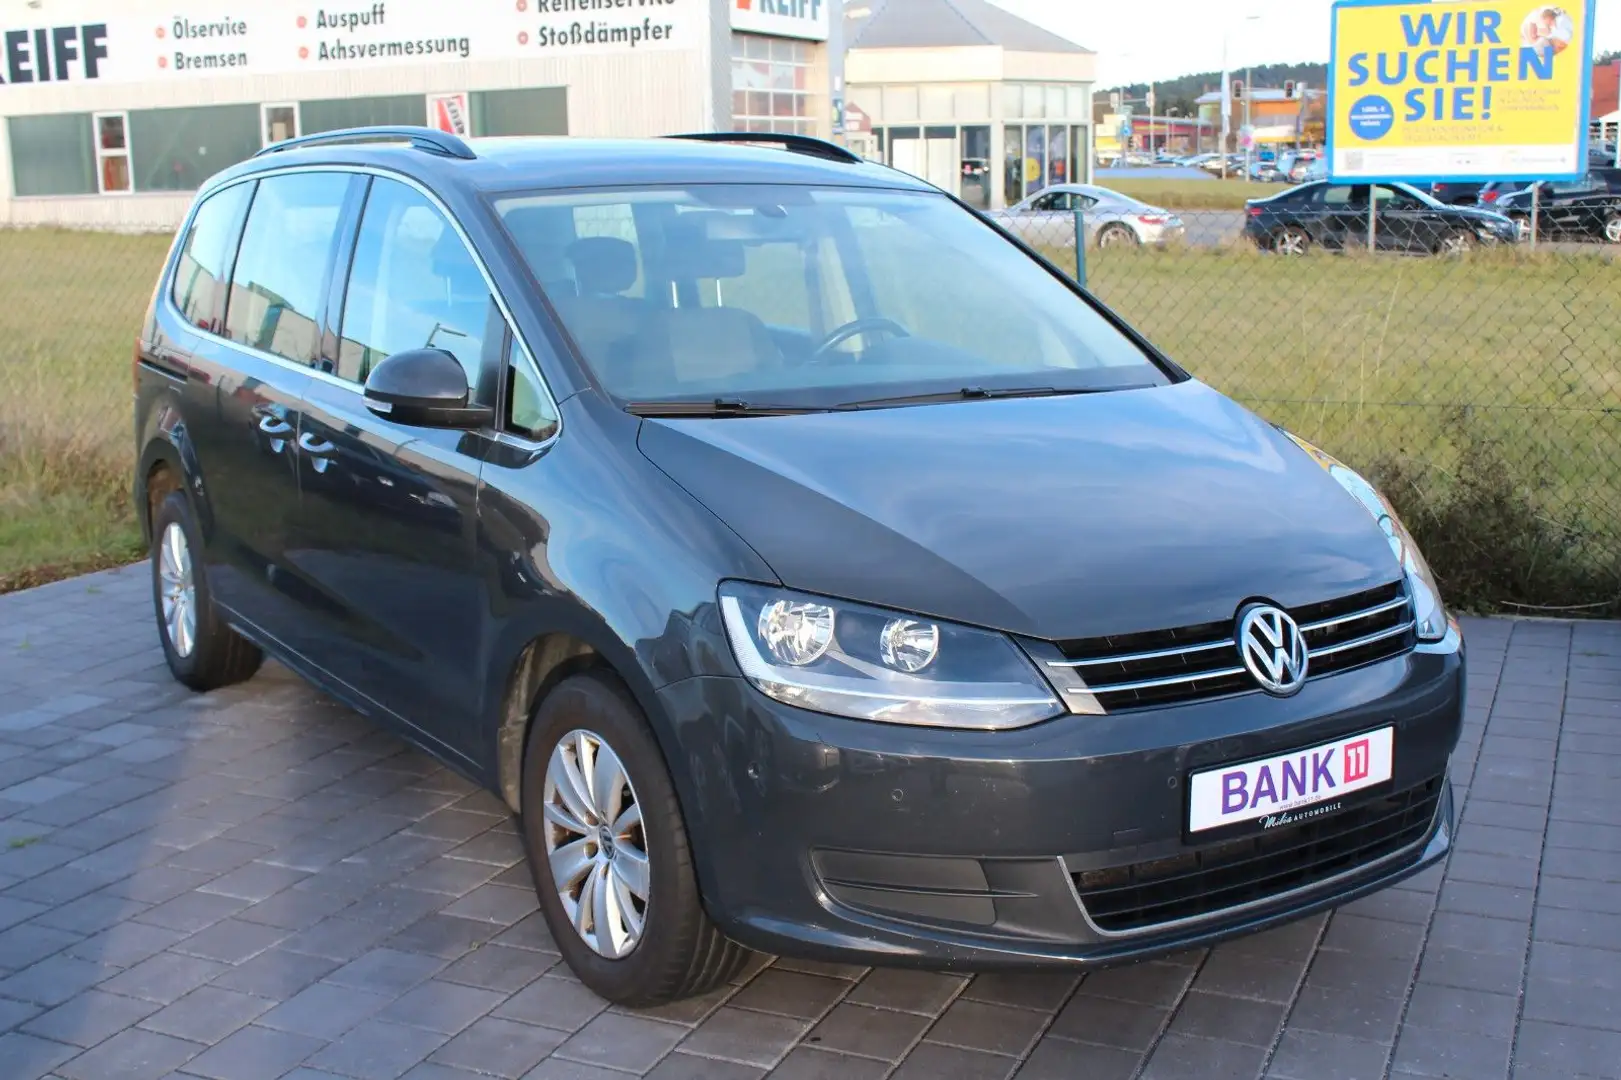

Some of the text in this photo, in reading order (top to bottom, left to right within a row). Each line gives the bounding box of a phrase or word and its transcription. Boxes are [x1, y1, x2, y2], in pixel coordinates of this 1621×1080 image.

[316, 6, 386, 30] Auspuff
[538, 0, 675, 13] Reifense
[172, 16, 248, 40] Ölservice
[539, 17, 673, 47] Stoßdämpfer
[1400, 10, 1502, 47] WIR
[0, 24, 108, 84] EIFF
[174, 52, 248, 70] Bremsen
[318, 35, 471, 62] Achsvermessung
[1348, 46, 1554, 87] SUCHEN
[1403, 86, 1493, 122] SIE!
[1221, 748, 1336, 816] BANK
[1294, 802, 1343, 821] AUTOMOBILE
